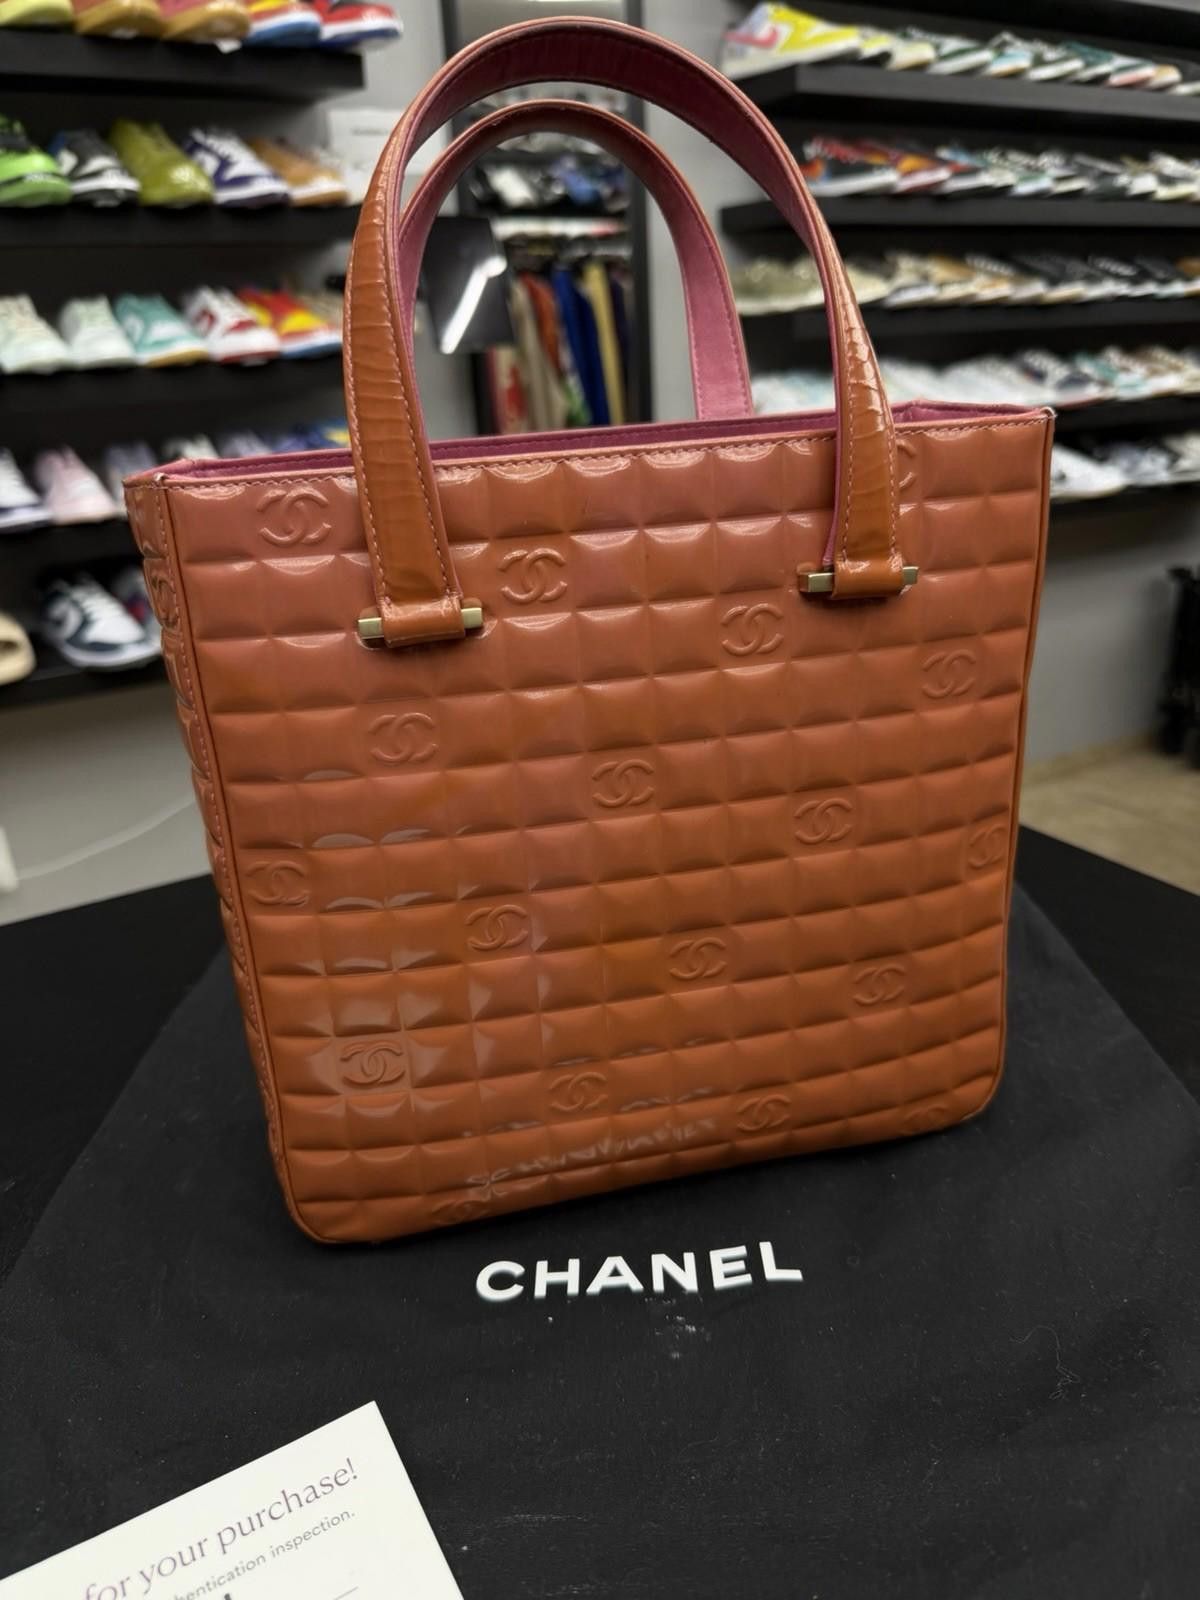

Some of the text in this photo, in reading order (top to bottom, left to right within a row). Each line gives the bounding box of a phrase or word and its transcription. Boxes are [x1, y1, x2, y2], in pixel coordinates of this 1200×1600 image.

[475, 1241, 804, 1301] CHANEL
[139, 1538, 208, 1595] your
[216, 1457, 358, 1555] purchase!
[270, 1509, 356, 1558] inspection.
